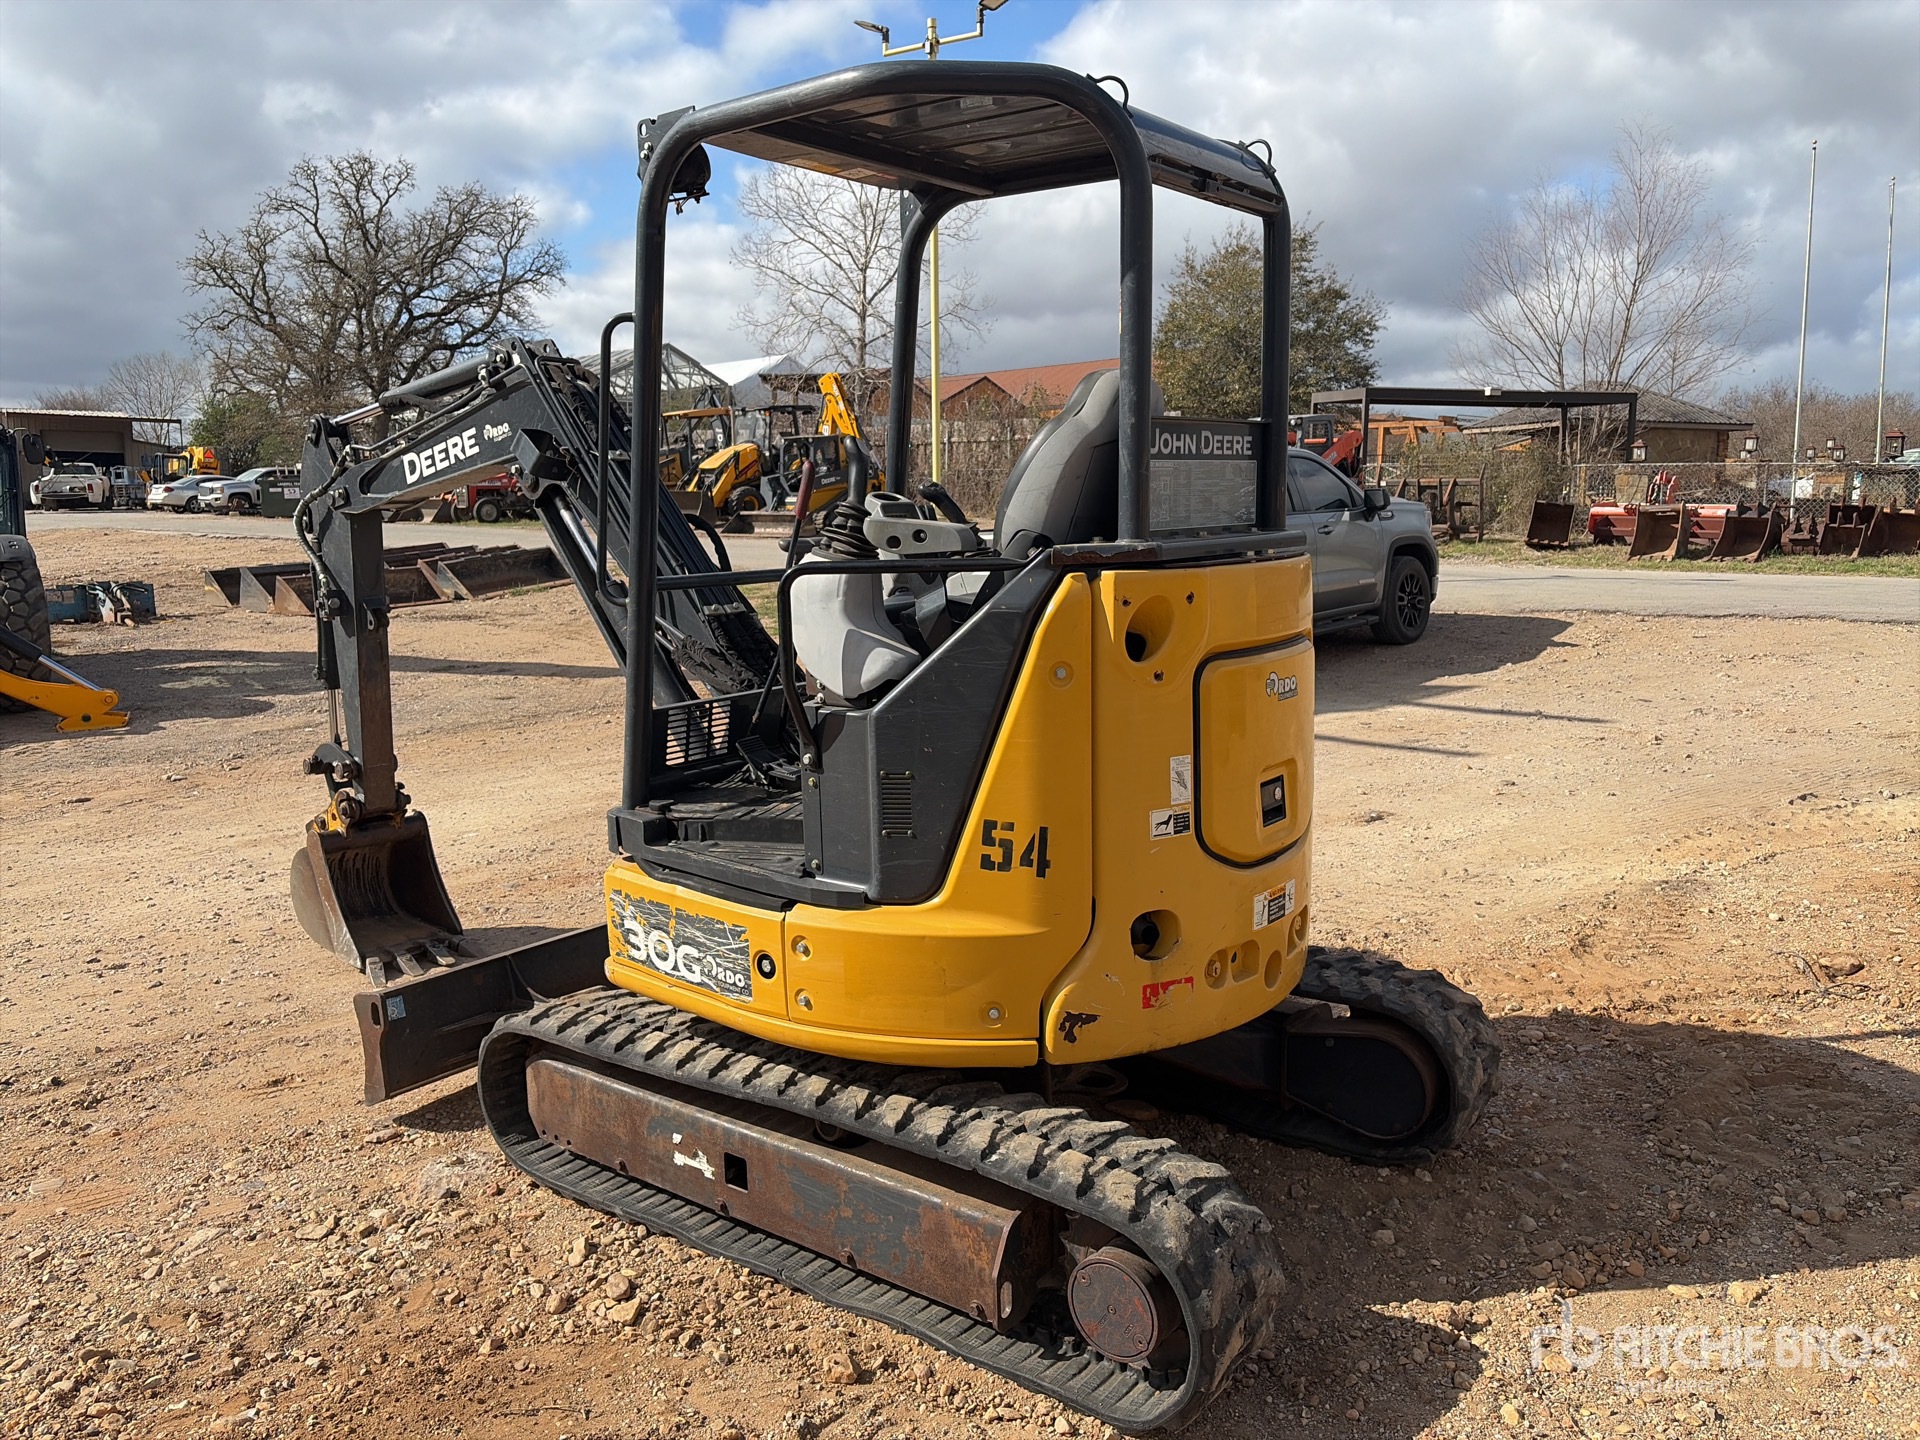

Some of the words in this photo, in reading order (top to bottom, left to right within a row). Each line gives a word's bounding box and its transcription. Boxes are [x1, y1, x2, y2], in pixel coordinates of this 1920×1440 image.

[1150, 427, 1197, 455] JOHN
[1201, 430, 1253, 455] DEERE
[402, 426, 480, 485] DEERE
[821, 477, 836, 485] DEERE
[1278, 675, 1297, 694] RDO
[980, 819, 1052, 879] 54
[623, 919, 702, 983] 30G
[717, 966, 746, 988] RDO
